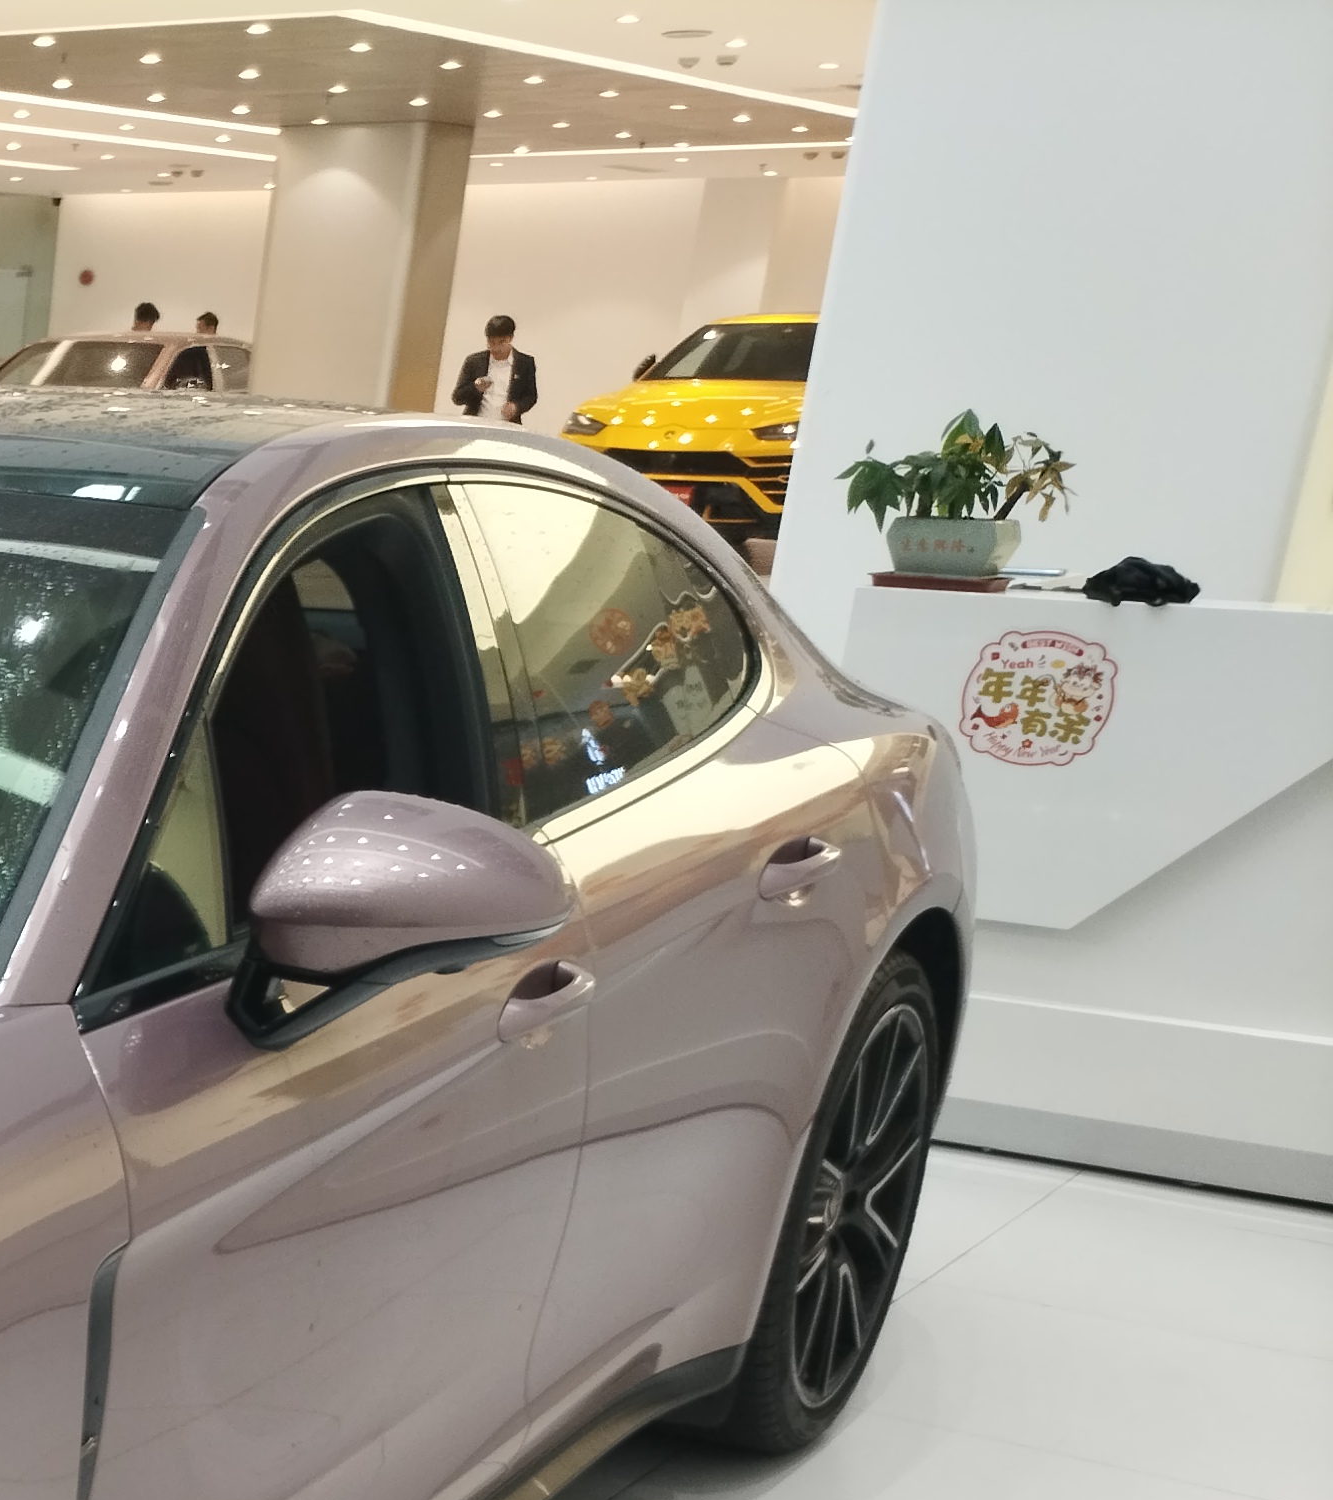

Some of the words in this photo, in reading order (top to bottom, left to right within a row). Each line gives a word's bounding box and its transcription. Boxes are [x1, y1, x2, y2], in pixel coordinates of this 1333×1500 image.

[1001, 657, 1034, 669] Yeah
[983, 731, 1013, 757] Happy
[1013, 746, 1038, 758] New
[1039, 744, 1062, 757] Year
